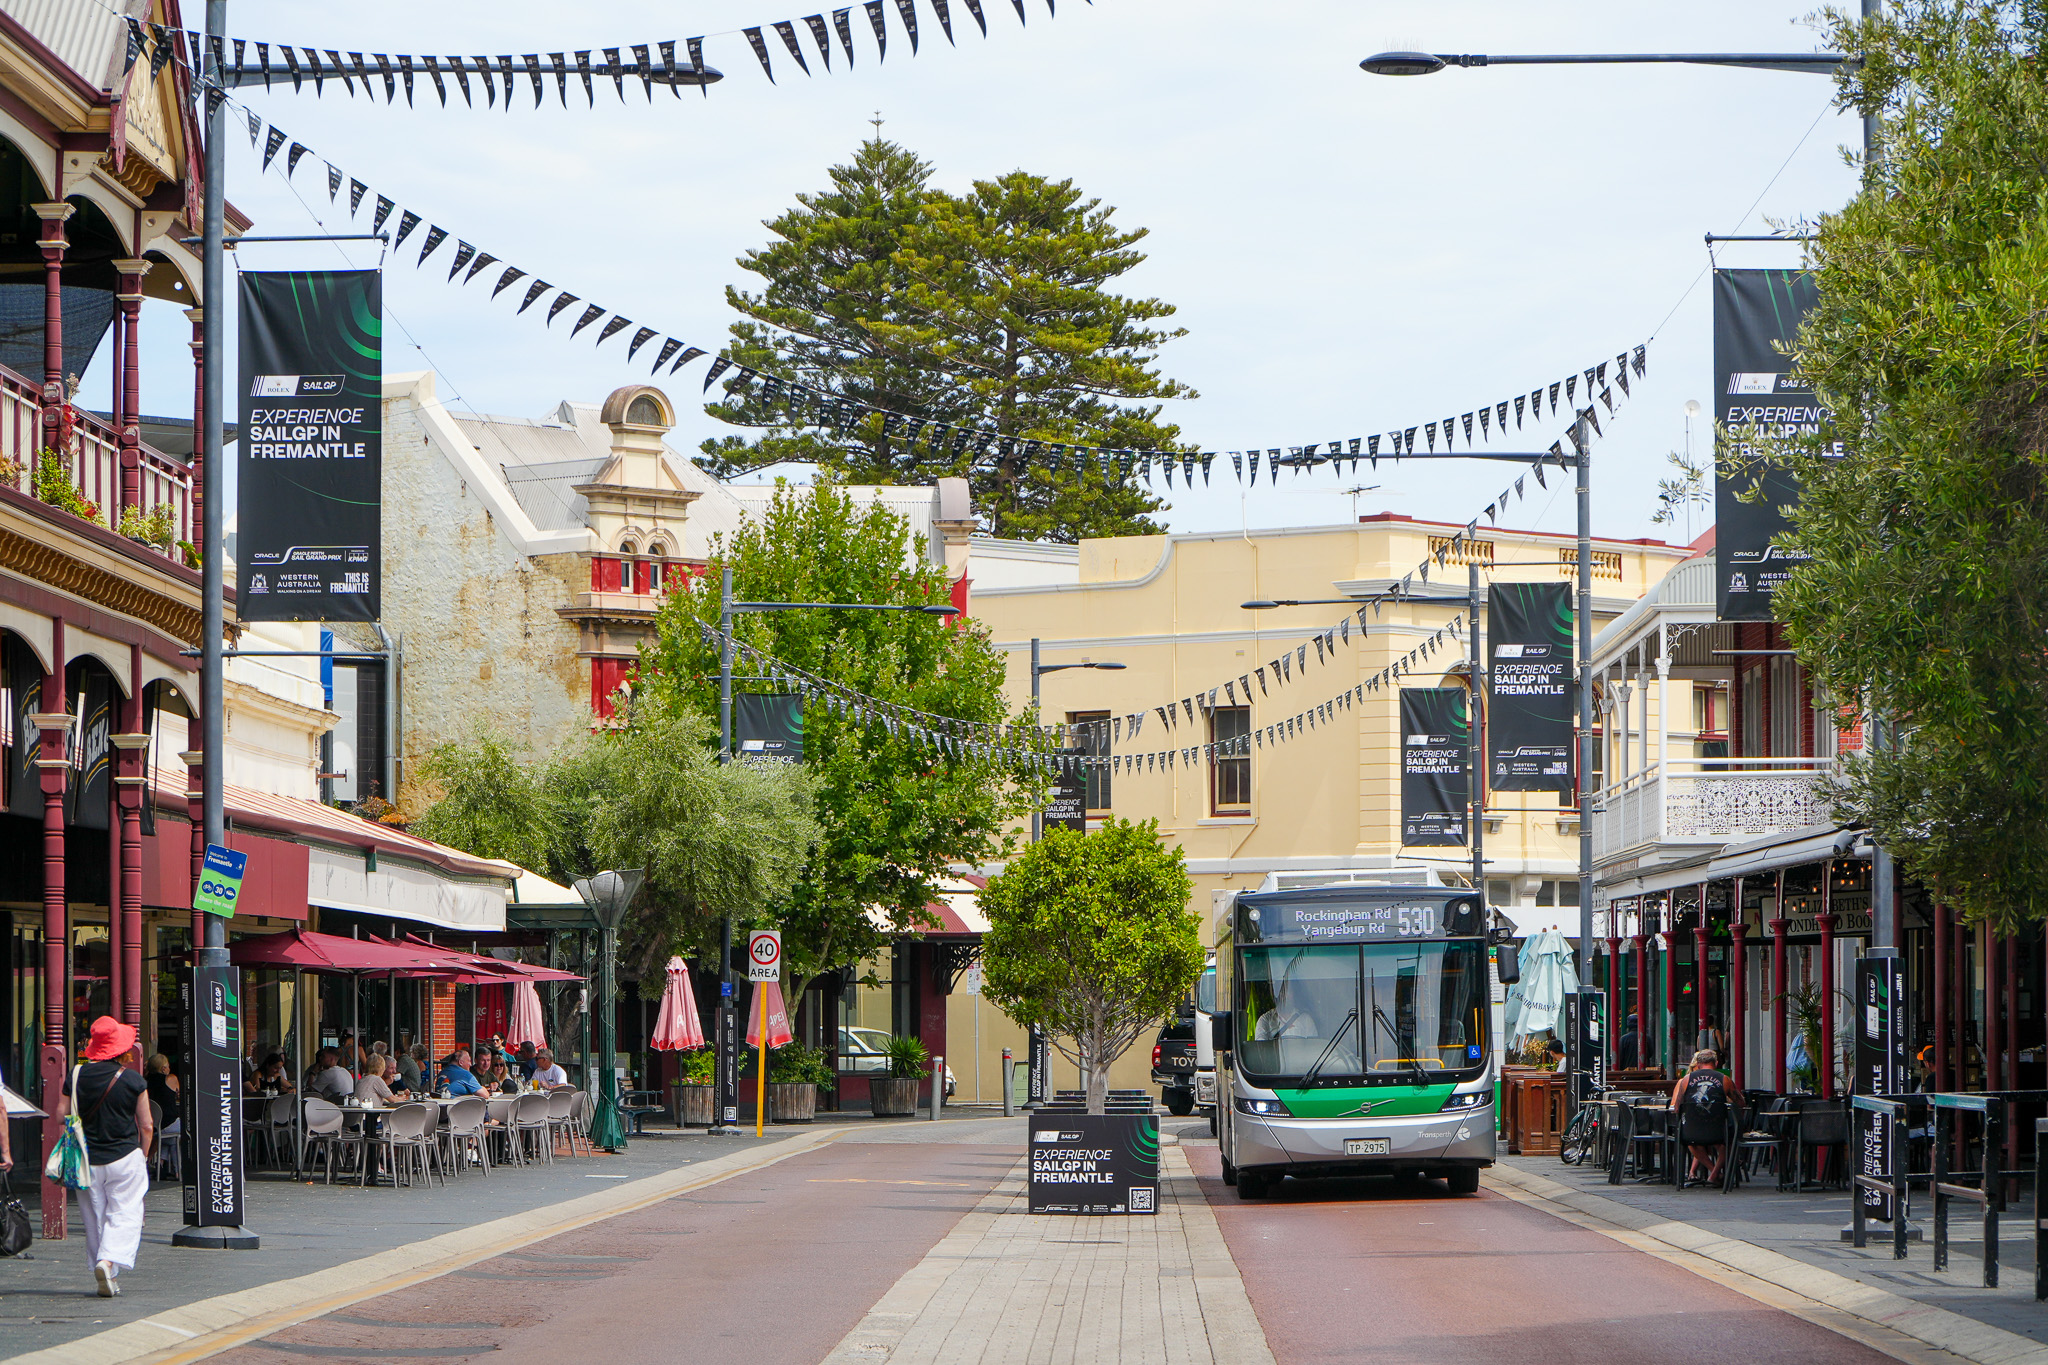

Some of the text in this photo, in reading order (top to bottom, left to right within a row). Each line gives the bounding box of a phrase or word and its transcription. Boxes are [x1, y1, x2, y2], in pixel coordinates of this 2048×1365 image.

[250, 408, 364, 424] EXPERIENCE
[250, 426, 340, 441] SAILGP IN
[250, 443, 366, 459] FREMANTLE
[344, 572, 369, 582] THIS IS
[330, 582, 369, 593] FREMANTLE
[1494, 664, 1563, 674] EXPERIENCE
[1494, 675, 1549, 684] SAILGP IN
[1494, 685, 1565, 695] FREMANTLE
[208, 855, 232, 868] Fremantle
[214, 886, 223, 895] 30
[222, 902, 234, 910] road
[1295, 908, 1391, 923] Rockingham Rd
[1398, 906, 1435, 936] 530
[1301, 923, 1385, 938] Yangebup Rd
[754, 943, 774, 956] 40
[750, 968, 778, 977] AREA
[1171, 1057, 1197, 1067] TOY
[1689, 1076, 1722, 1088] SALTY LIFE
[1418, 1130, 1452, 1139] Transperth
[220, 1072, 234, 1214] SAILGP IN FREMANTLE
[1034, 1149, 1112, 1160] EXPERIENCE
[1873, 1148, 1882, 1158] IN
[1034, 1161, 1096, 1171] SAILGP IN
[210, 1136, 222, 1214] EXPERIENCE
[1034, 1173, 1114, 1183] FREMANTLE
